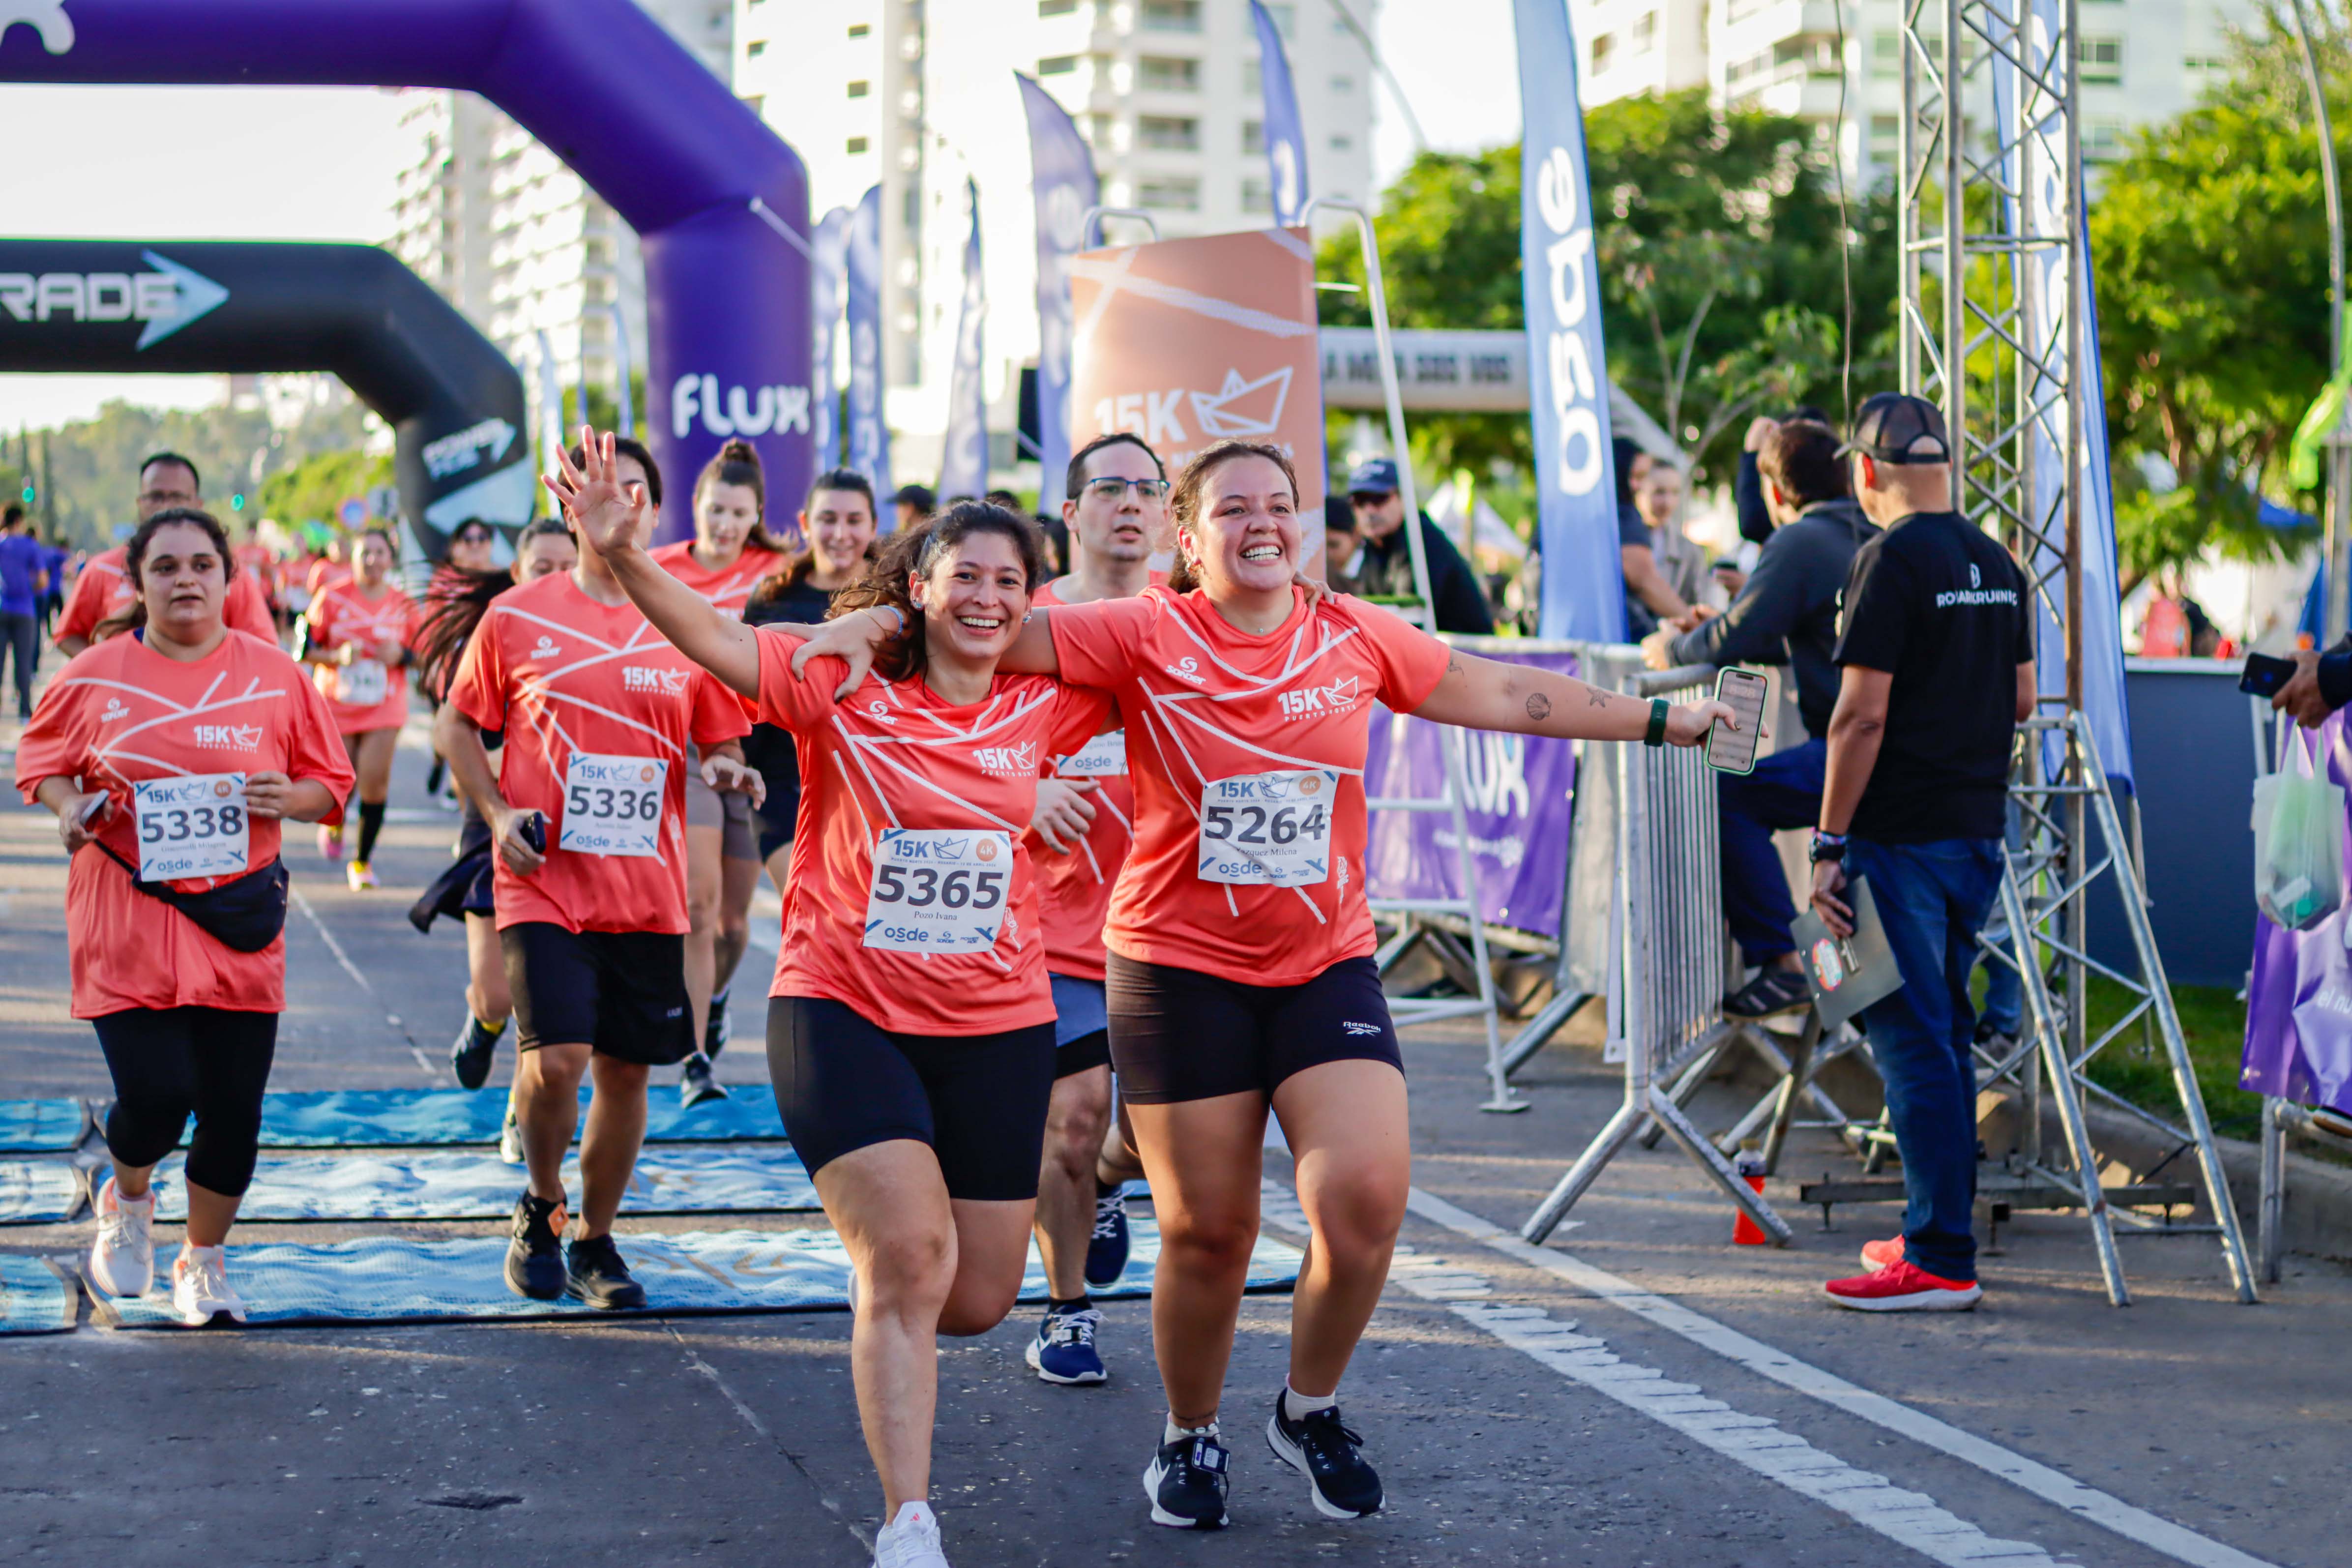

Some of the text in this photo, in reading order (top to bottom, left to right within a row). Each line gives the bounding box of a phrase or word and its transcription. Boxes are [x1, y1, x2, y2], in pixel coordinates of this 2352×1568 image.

[1094, 389, 1187, 444] 15K
[621, 666, 658, 686] 15K
[1277, 687, 1324, 714] 15K
[1284, 711, 1325, 722] PUERTO
[193, 725, 230, 744] 15K
[972, 747, 1014, 769] 15K
[1075, 755, 1112, 770] osde
[581, 765, 608, 779] 15K
[147, 788, 176, 803] 15K
[1219, 781, 1255, 798] 15K
[568, 785, 658, 821] 5336
[142, 805, 243, 843] 5338
[1205, 804, 1325, 844] 5264
[576, 835, 610, 848] osde
[893, 839, 993, 858] 15K 4K
[157, 858, 193, 873] osde
[1218, 860, 1263, 877] osde
[874, 864, 1003, 909] 5365
[914, 911, 957, 920] Pozo Ivana
[884, 927, 929, 942] osde
[1343, 1021, 1381, 1032] Reebok
